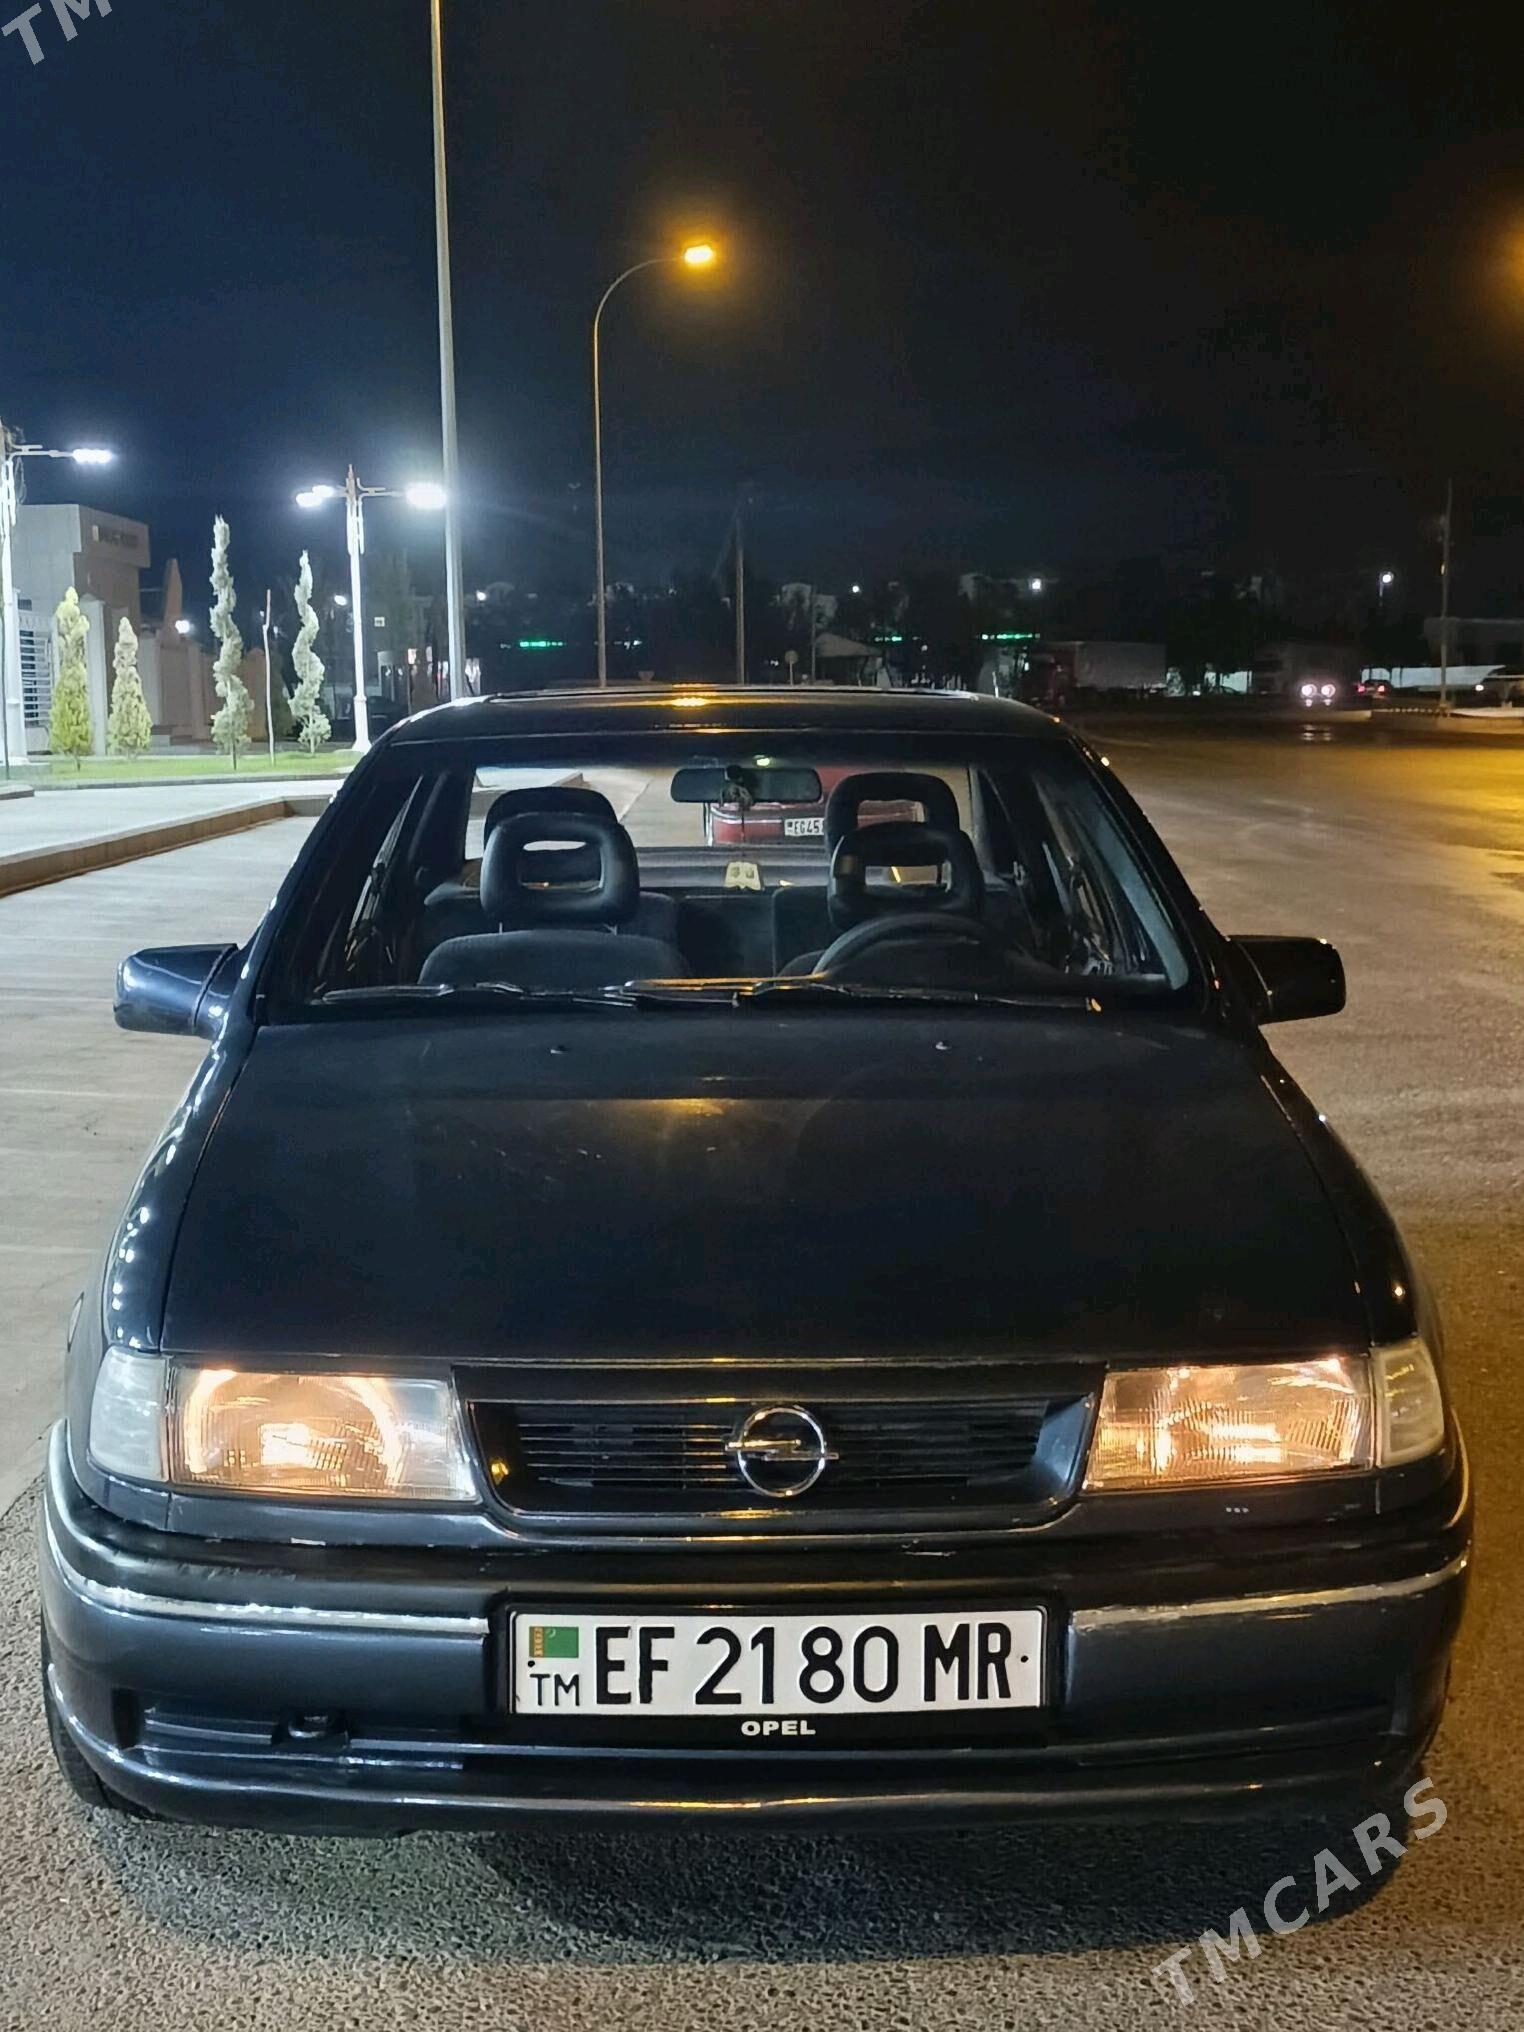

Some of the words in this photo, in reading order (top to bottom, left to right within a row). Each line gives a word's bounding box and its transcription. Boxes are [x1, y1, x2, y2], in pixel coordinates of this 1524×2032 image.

[596, 1626, 675, 1704] EF
[695, 1625, 898, 1705] 2180
[924, 1622, 1012, 1702] MR
[529, 1673, 580, 1706] TM
[741, 1720, 816, 1736] OPEL
